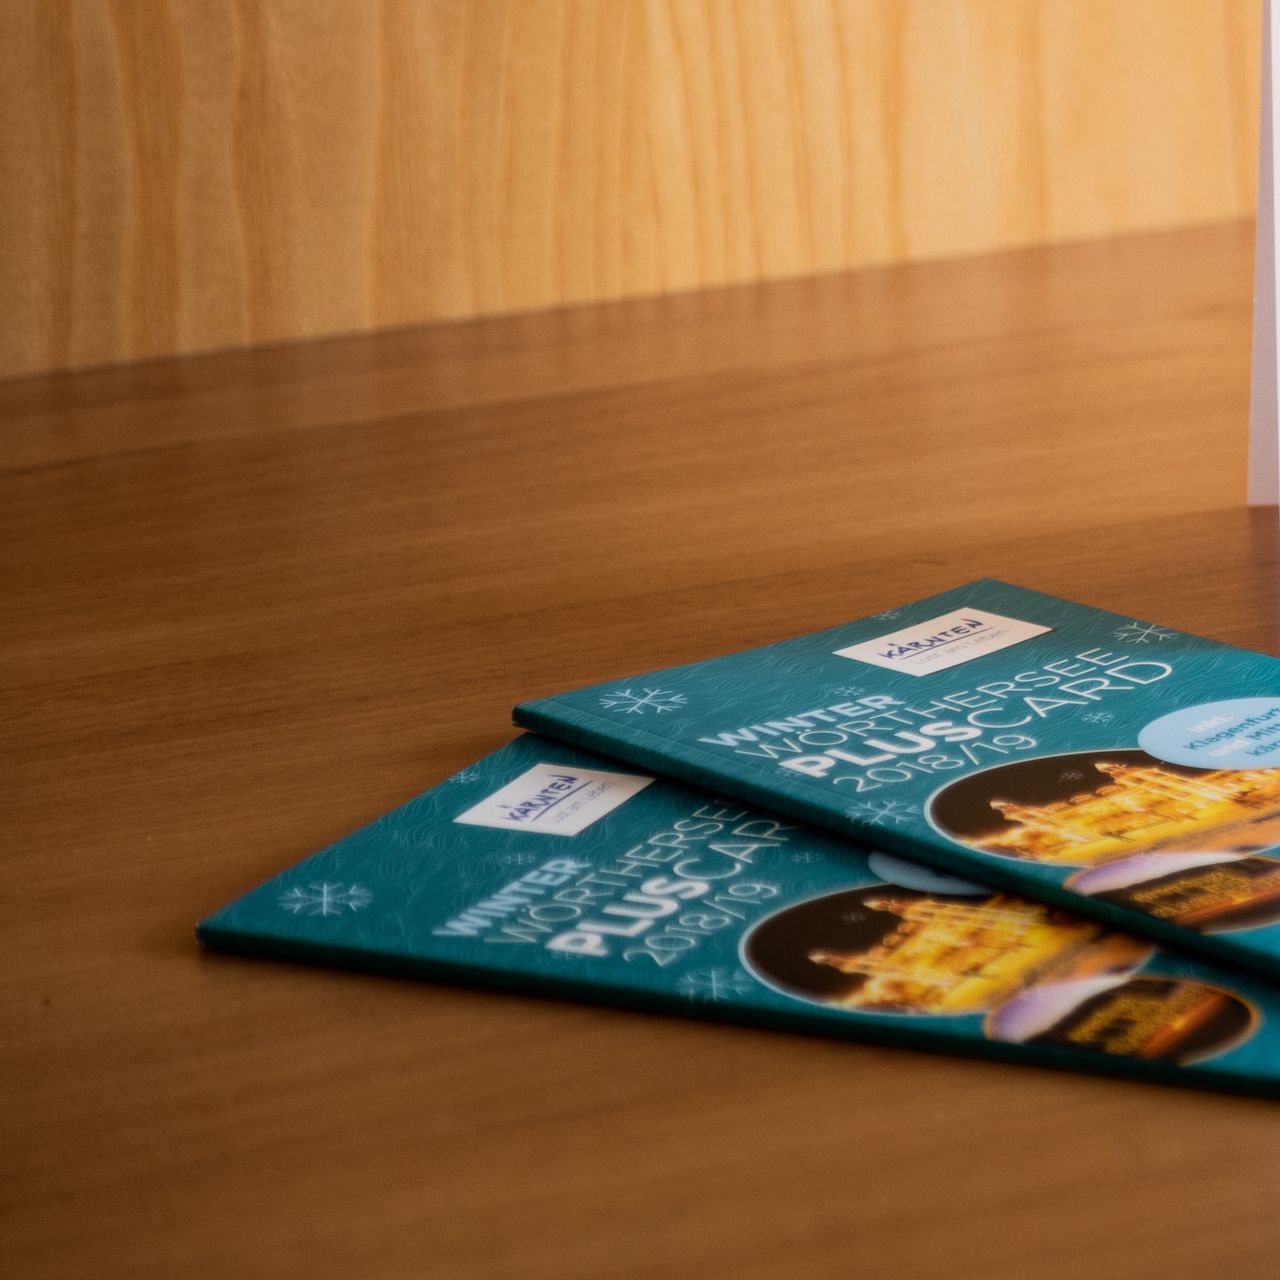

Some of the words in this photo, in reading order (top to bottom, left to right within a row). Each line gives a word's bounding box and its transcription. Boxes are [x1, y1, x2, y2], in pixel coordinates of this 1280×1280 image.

[877, 617, 985, 661] KÄRNTEN
[697, 694, 906, 749] WINTER
[734, 647, 1131, 761] WÖRTHERSEE
[777, 661, 1174, 779] PLUSCARD
[496, 774, 579, 822] KÄRNTEN
[832, 732, 1037, 794] 2018/19
[431, 856, 593, 938] WINTER
[484, 799, 748, 945] WÖRTHERSE
[544, 819, 800, 958] PLUSCAR
[621, 882, 779, 969] 2018/19
